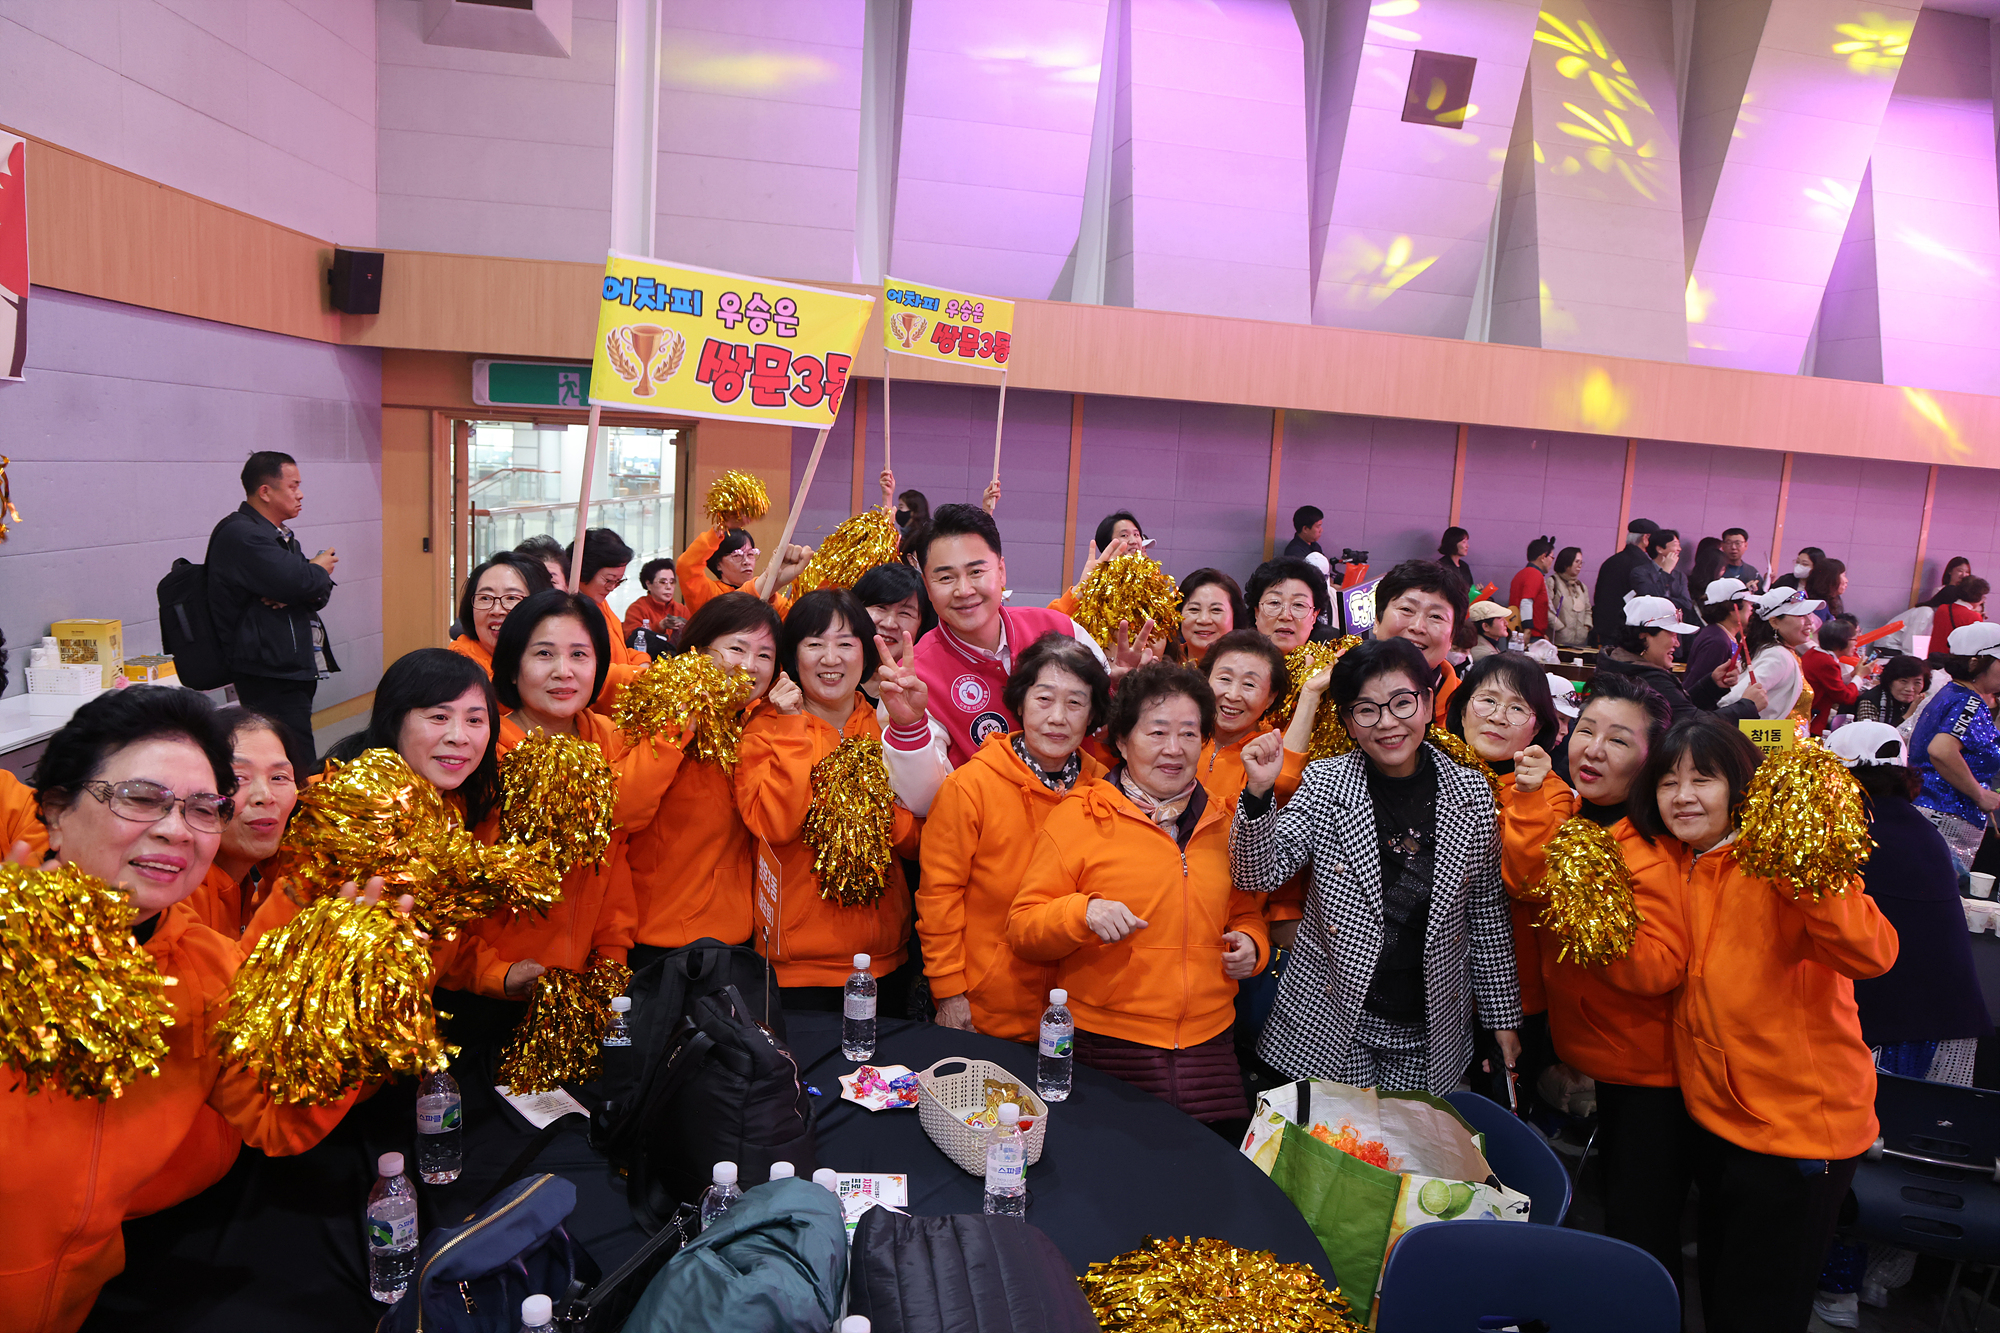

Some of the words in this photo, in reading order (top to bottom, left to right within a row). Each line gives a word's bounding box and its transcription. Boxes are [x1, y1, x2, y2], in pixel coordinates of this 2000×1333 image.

[602, 276, 703, 317] 어차피
[716, 291, 800, 338] 우승은
[886, 289, 940, 312] 어차피
[945, 299, 984, 323] 우승은
[930, 321, 1011, 364] 쌍문3동
[1751, 729, 1781, 742] 창1동
[419, 1113, 441, 1123] 스파클
[998, 1166, 1022, 1175] 스파클
[851, 1178, 861, 1191] 프로
